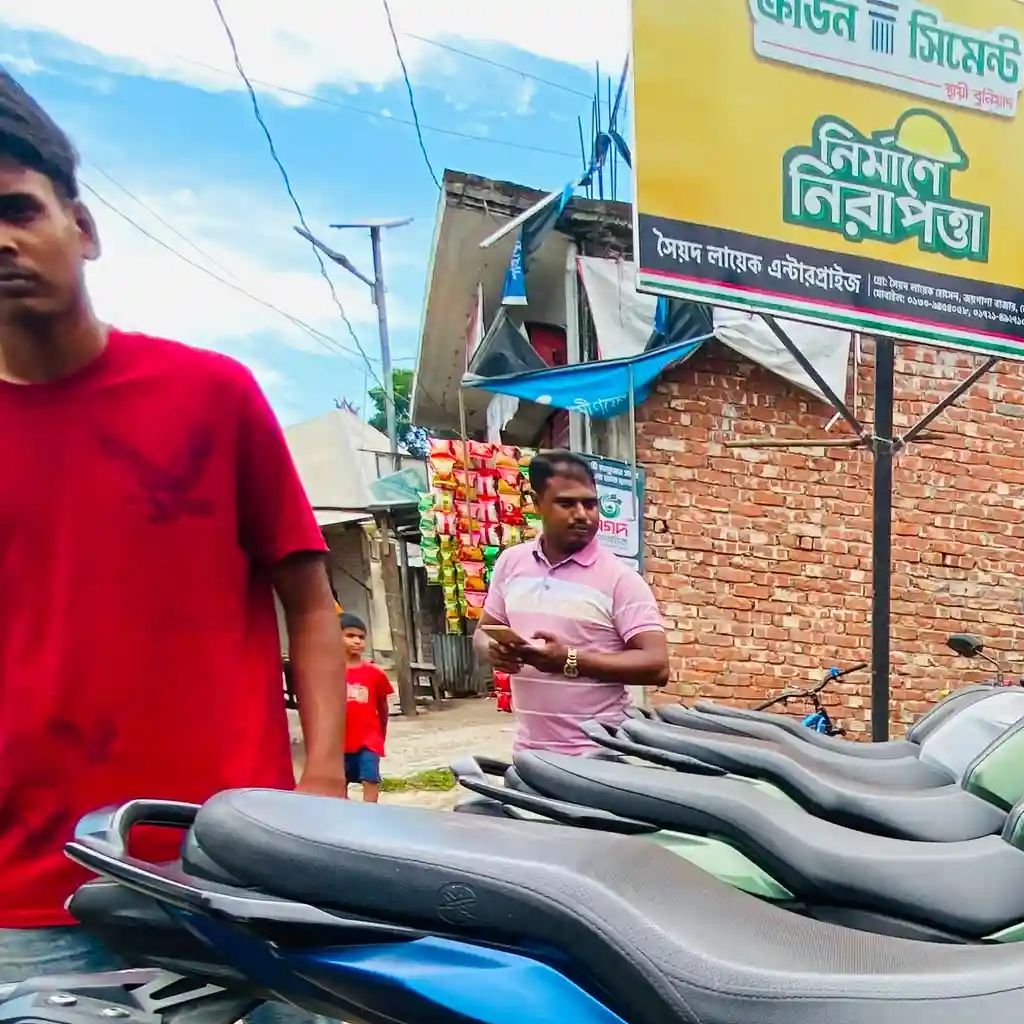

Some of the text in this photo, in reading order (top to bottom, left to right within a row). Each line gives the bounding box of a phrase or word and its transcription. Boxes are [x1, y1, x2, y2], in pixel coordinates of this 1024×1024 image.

[908, 9, 1022, 84] সিমেন্ট
[818, 121, 945, 198] নির্মাণে
[788, 154, 984, 253] নিরাপত্তা
[652, 228, 863, 294] সৈয়দ লায়েক এন্টারপ্রাইজ
